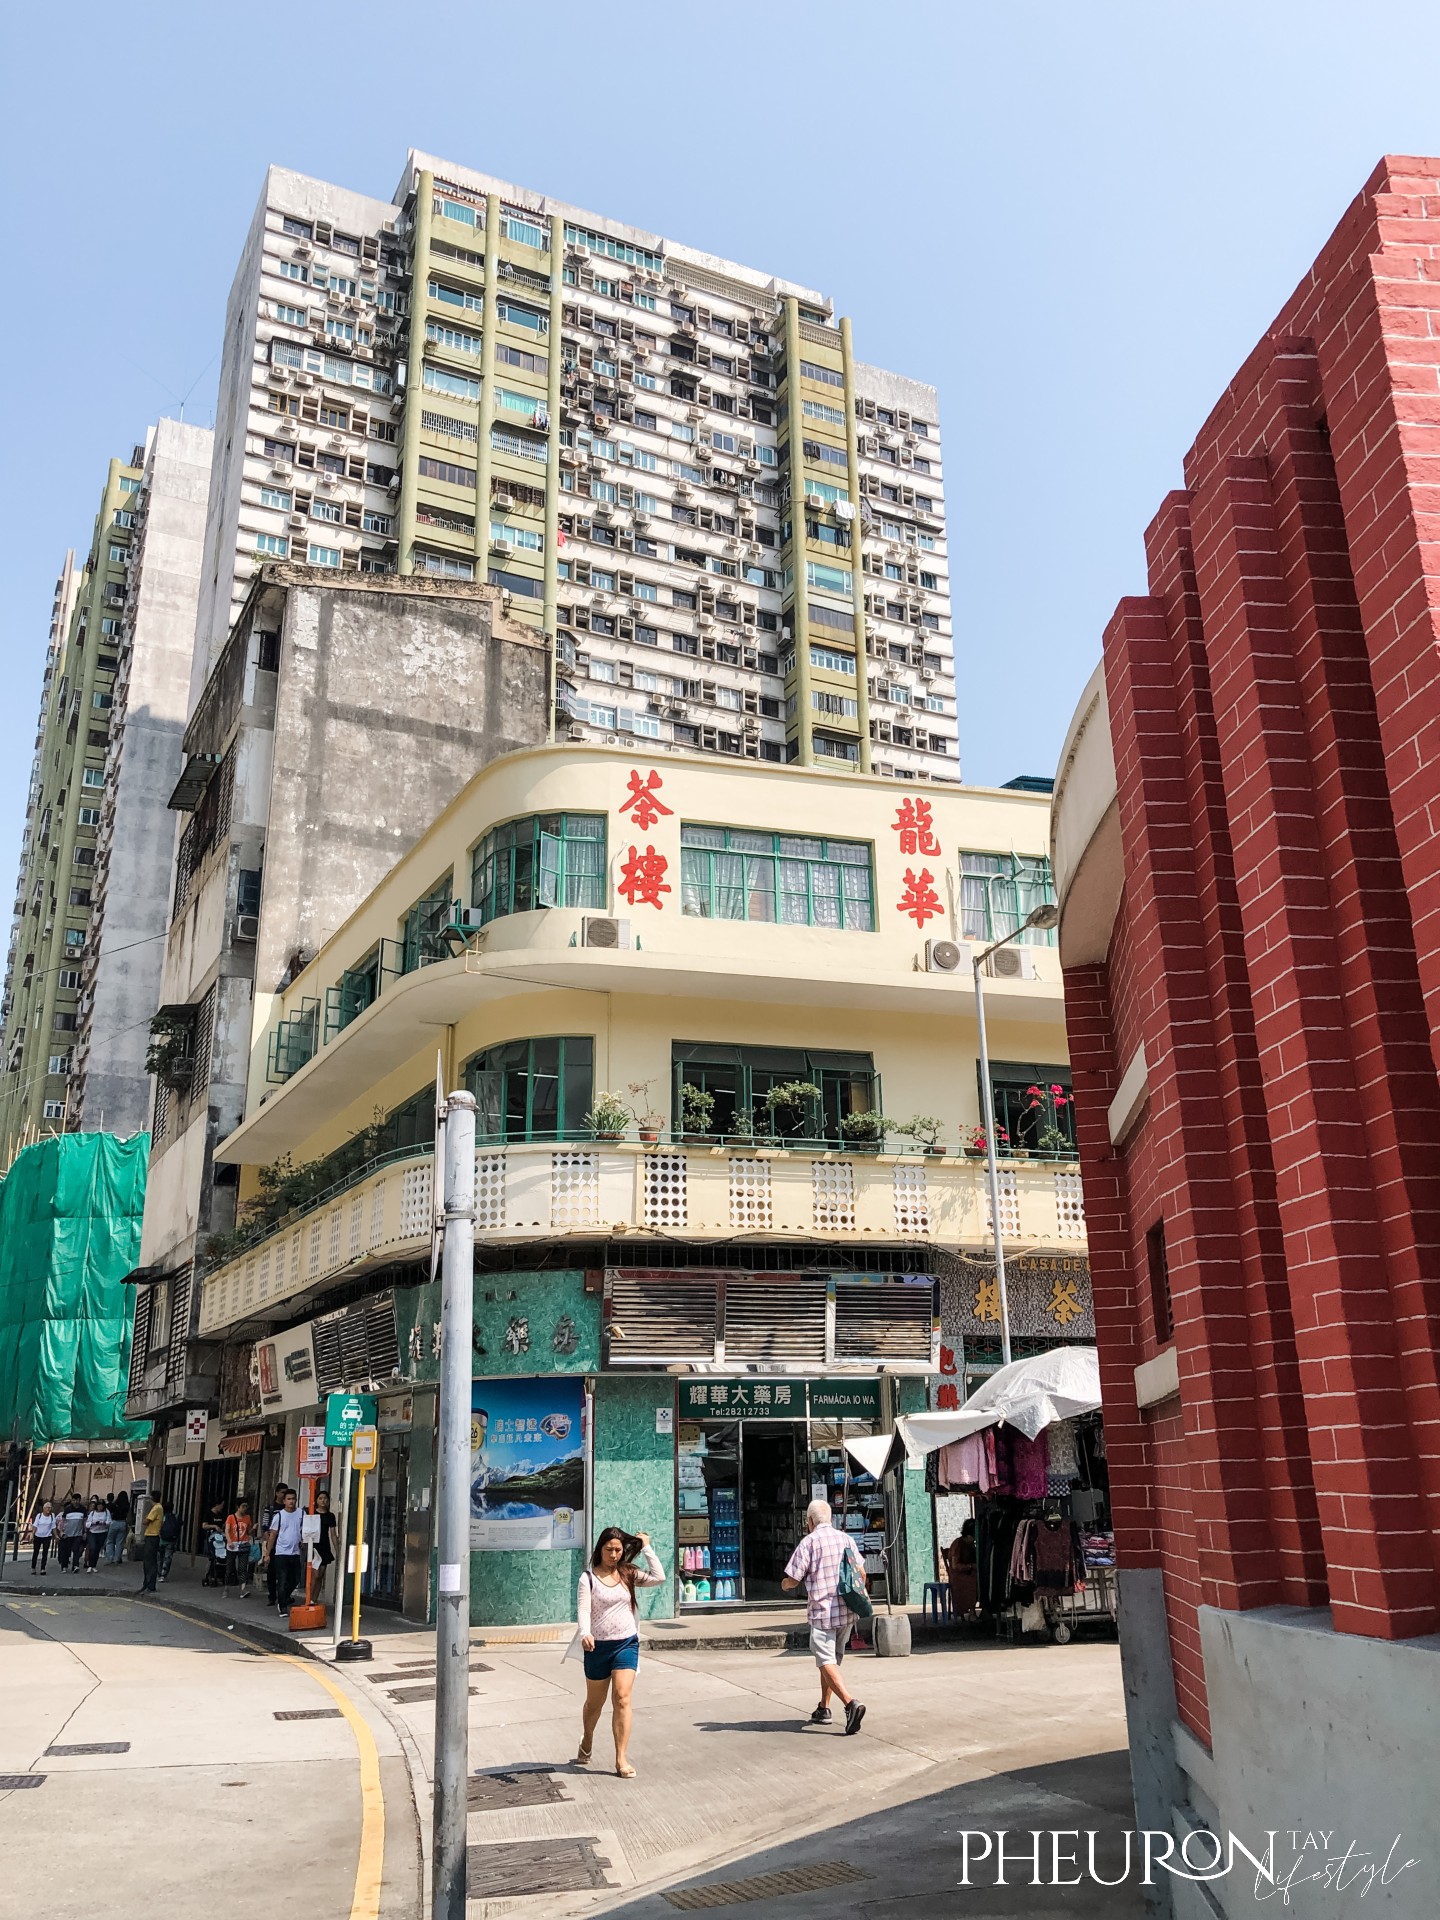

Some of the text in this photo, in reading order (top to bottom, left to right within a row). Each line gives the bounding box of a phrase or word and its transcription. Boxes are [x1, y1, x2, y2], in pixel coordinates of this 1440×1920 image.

[618, 769, 674, 911] 茶樓
[891, 796, 945, 930] 龍華
[1019, 1257, 1057, 1272] CASA
[1063, 1257, 1081, 1272] DE
[689, 1385, 792, 1405] 耀華大藥房
[813, 1392, 851, 1405] FARMÁCIA
[862, 1394, 875, 1405] WA
[710, 1407, 770, 1416] Tel:28212733
